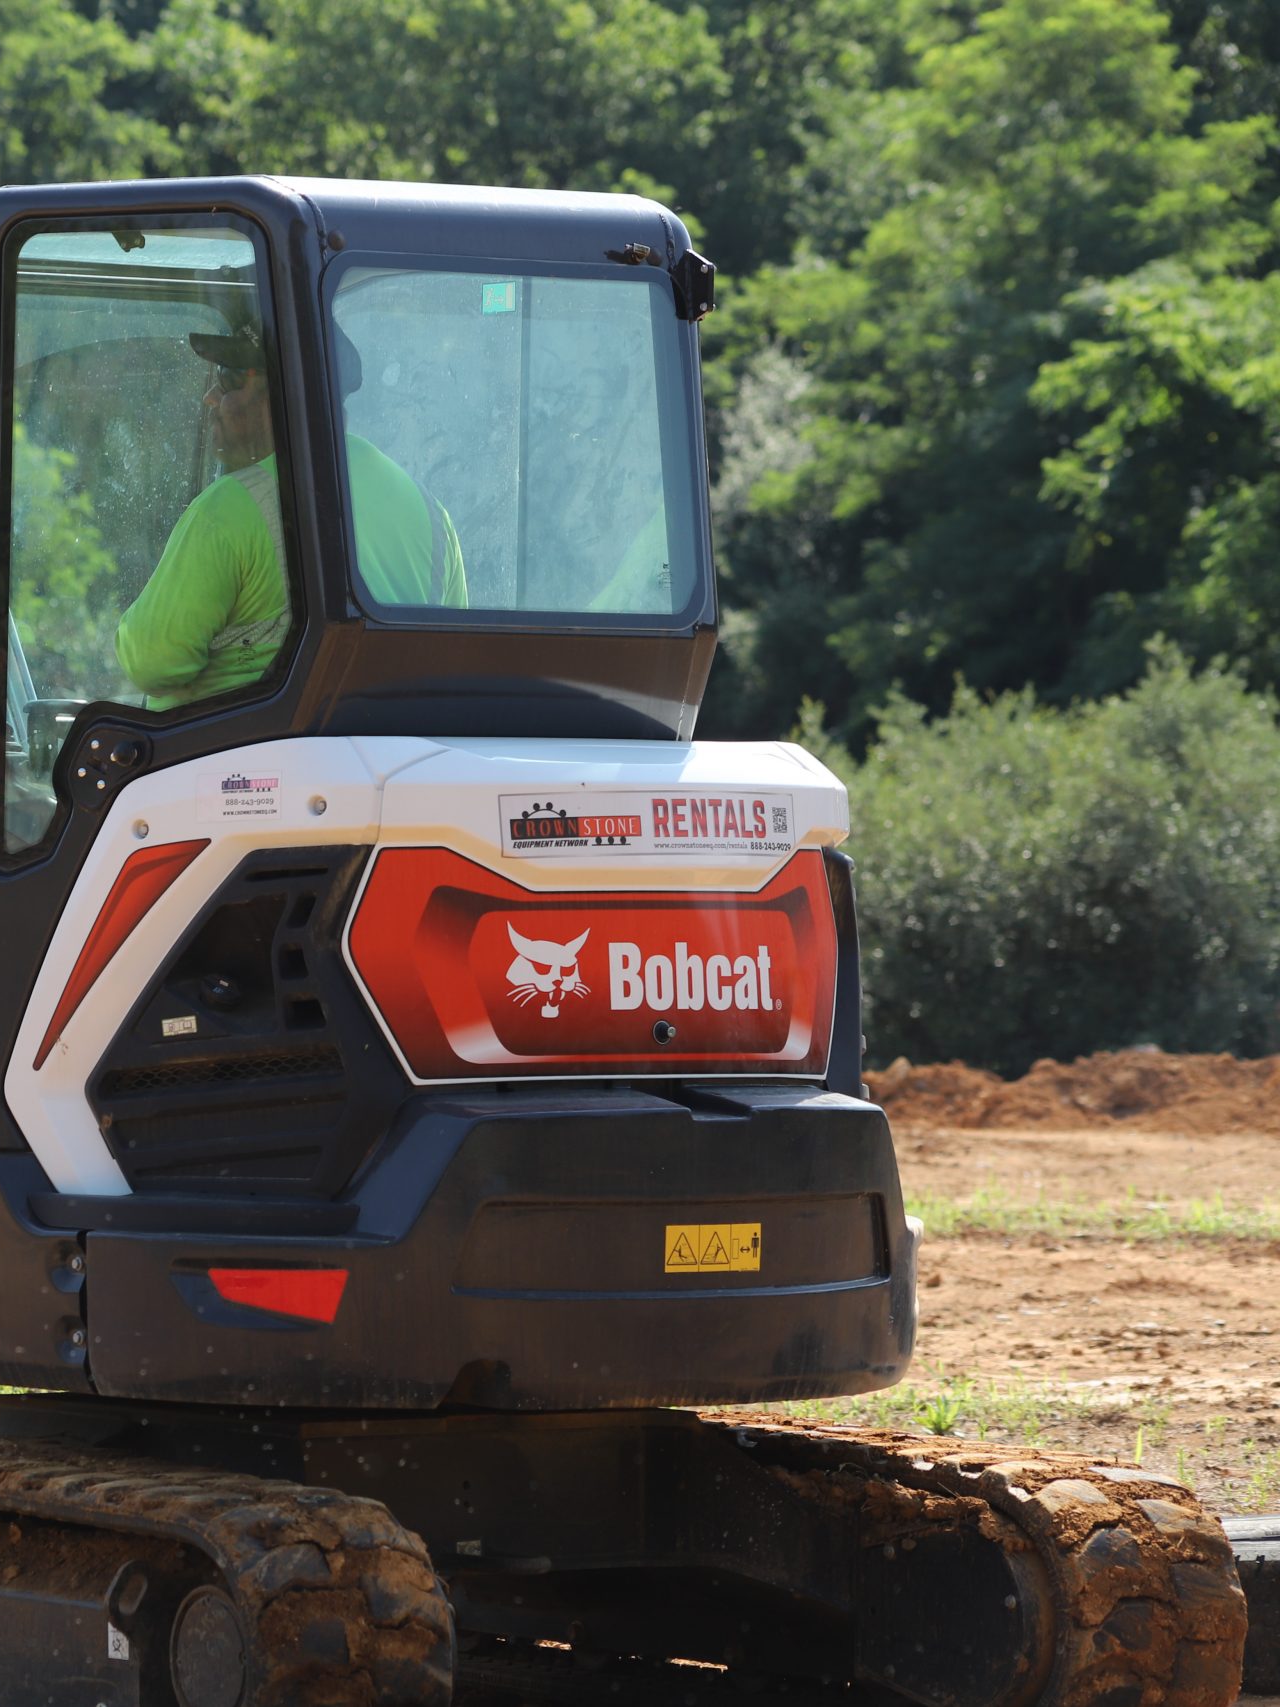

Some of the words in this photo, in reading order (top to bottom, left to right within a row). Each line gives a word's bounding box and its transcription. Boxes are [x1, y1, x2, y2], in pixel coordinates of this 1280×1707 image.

[651, 798, 766, 837] RENTALS
[512, 840, 552, 849] EQUIPMENT
[554, 839, 589, 848] NETWORK
[750, 841, 792, 851] 888-243-9029
[608, 942, 774, 1011] Bobcat
